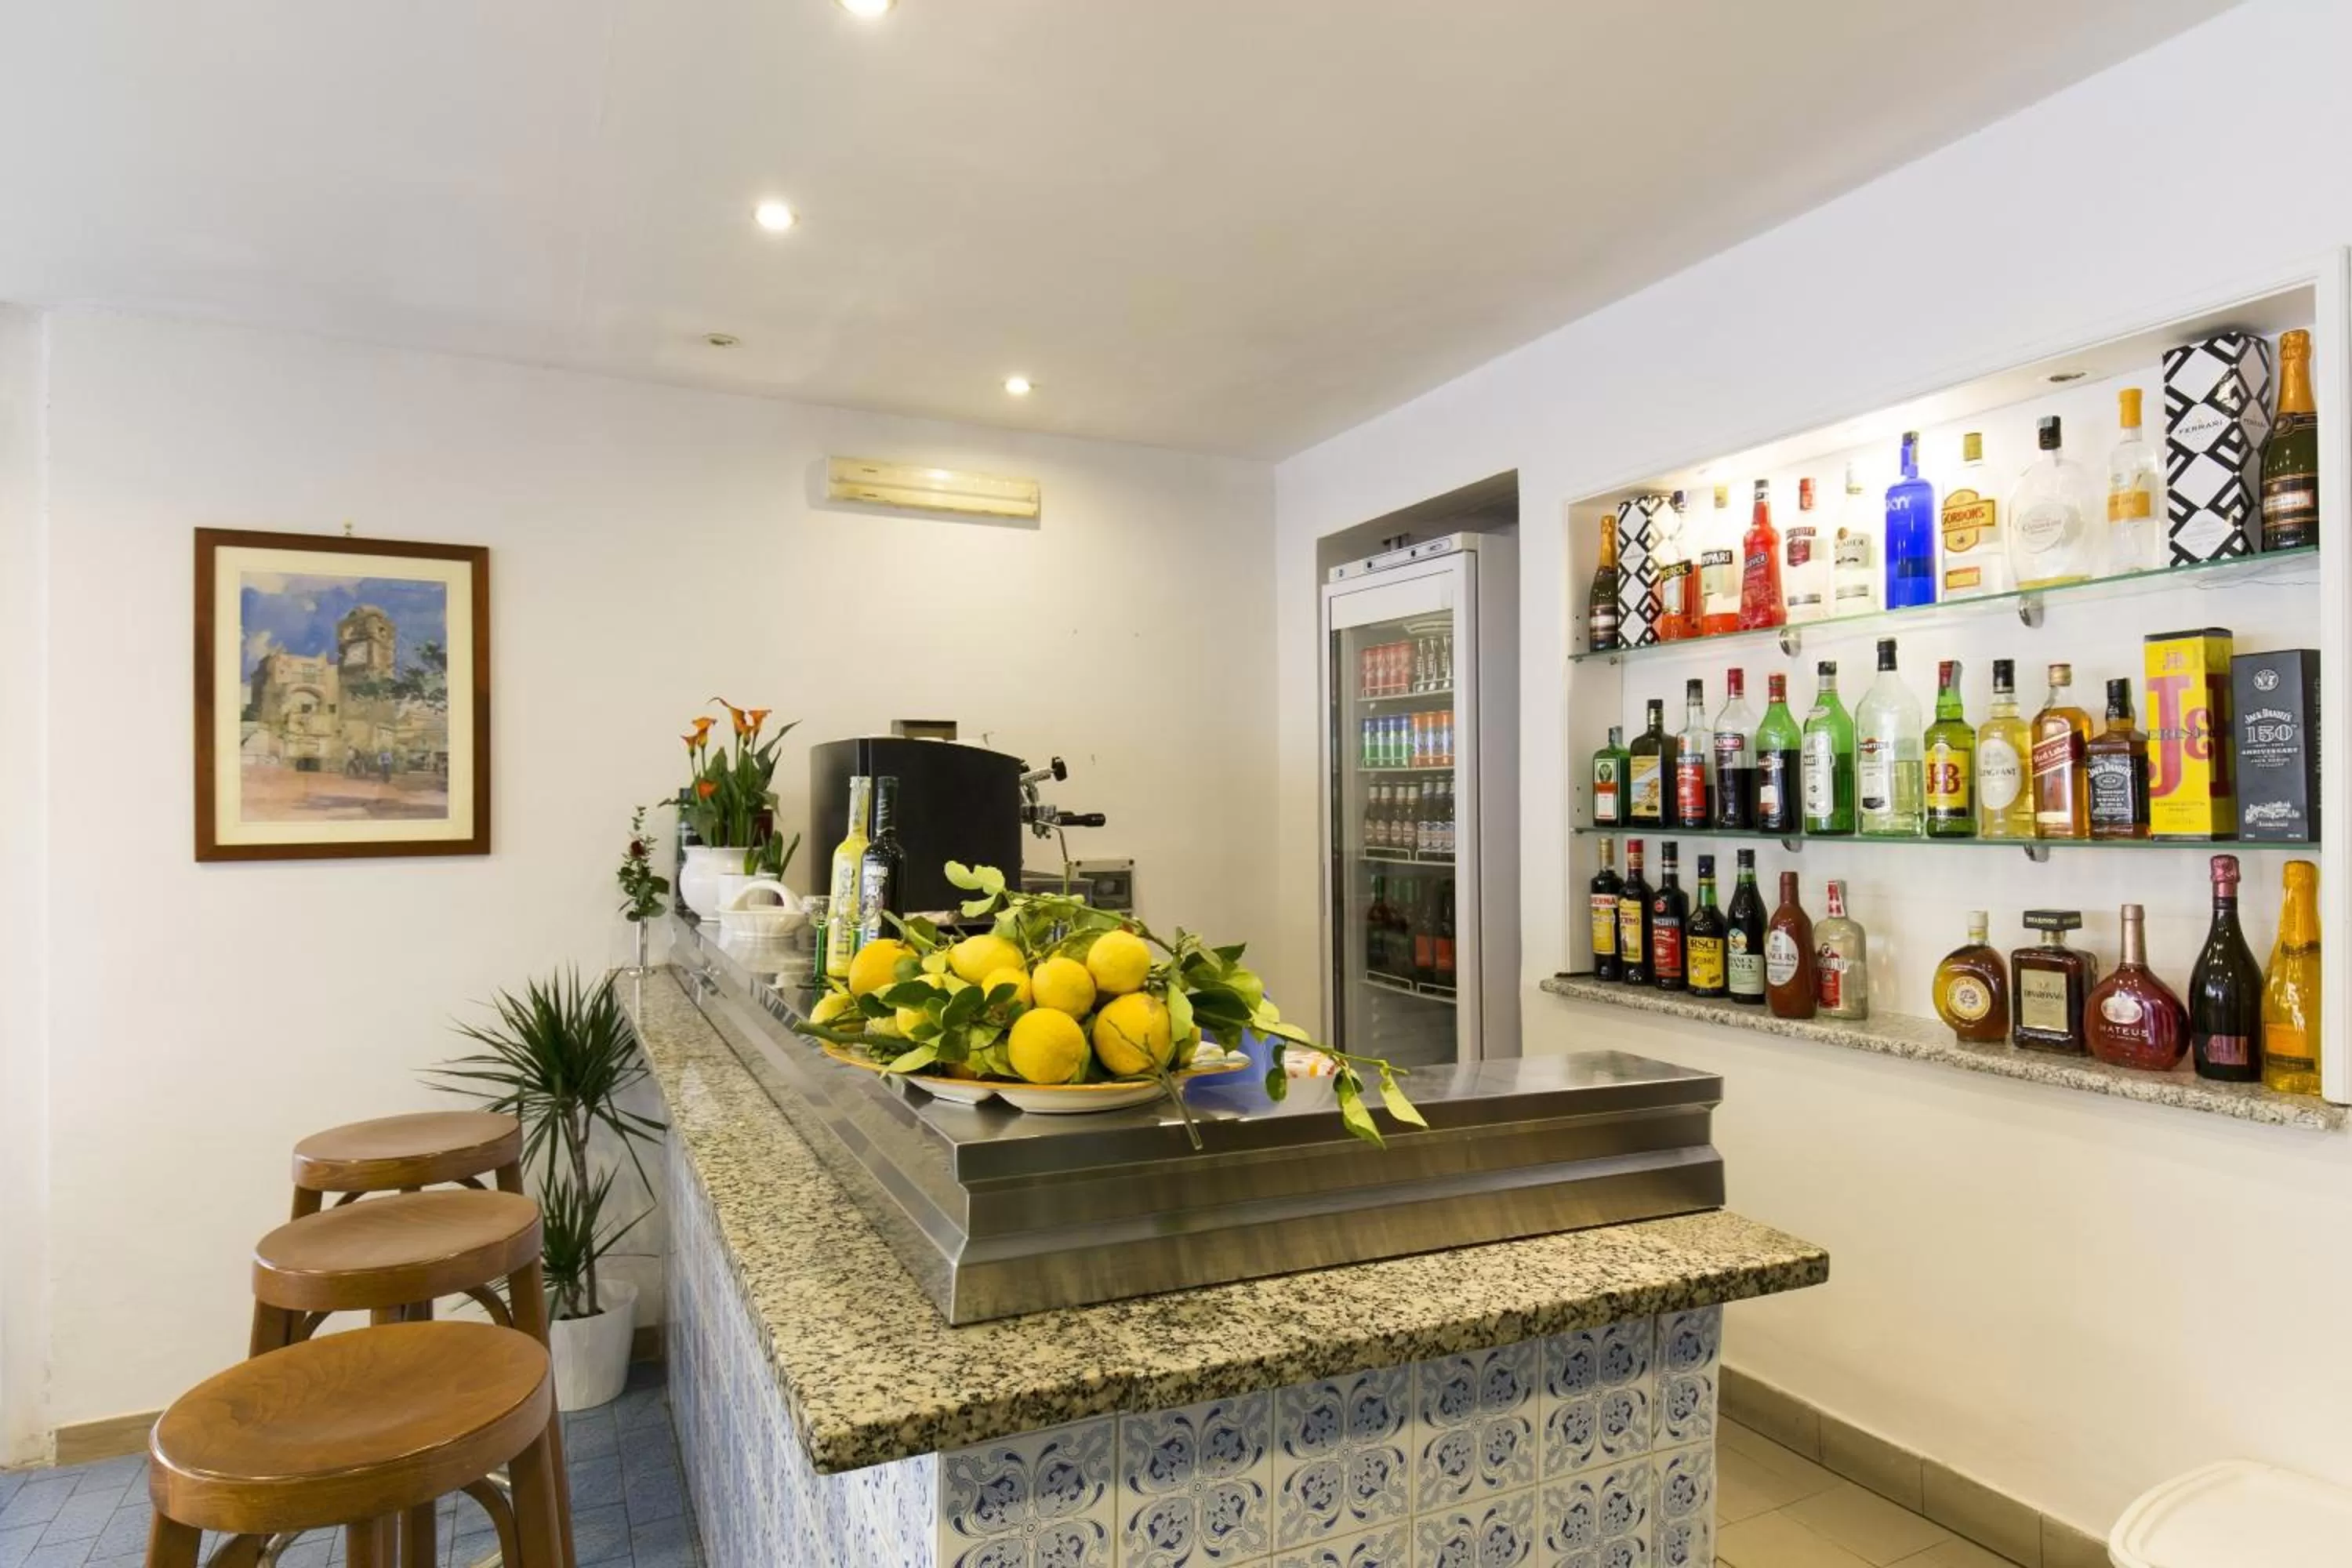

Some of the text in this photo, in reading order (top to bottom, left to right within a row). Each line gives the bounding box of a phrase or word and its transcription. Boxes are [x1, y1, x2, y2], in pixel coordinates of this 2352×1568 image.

[2178, 419, 2223, 434] FERRARI
[2244, 710, 2263, 725] JACK
[2098, 1024, 2149, 1038] MATEUS
